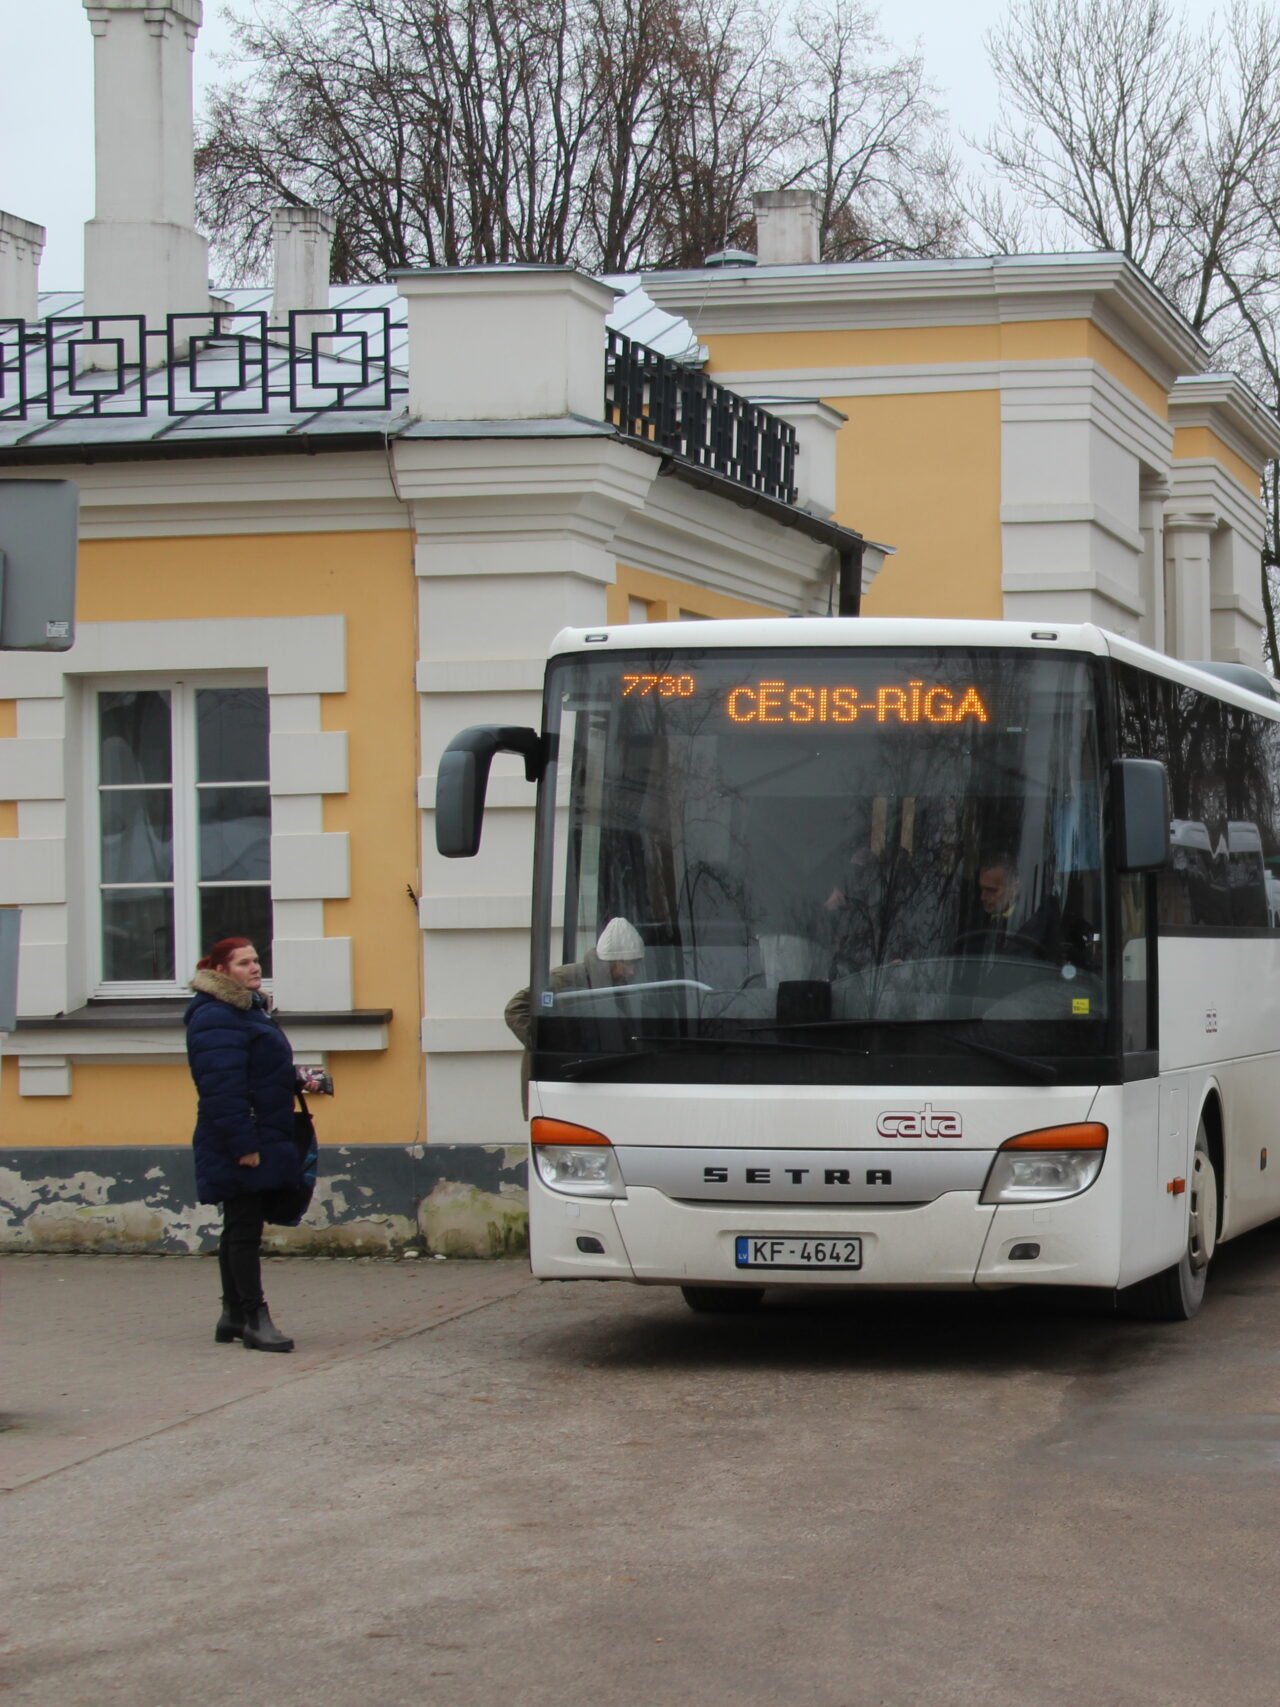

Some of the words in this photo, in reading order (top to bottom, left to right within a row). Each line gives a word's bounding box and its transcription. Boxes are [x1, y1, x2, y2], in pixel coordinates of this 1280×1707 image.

[622, 674, 695, 697] 7730
[727, 680, 988, 723] CĒSIS-RĪGA
[876, 1103, 963, 1138] cata
[703, 1167, 892, 1186] SETRA
[738, 1252, 748, 1260] LV
[753, 1241, 857, 1264] KF-4642
